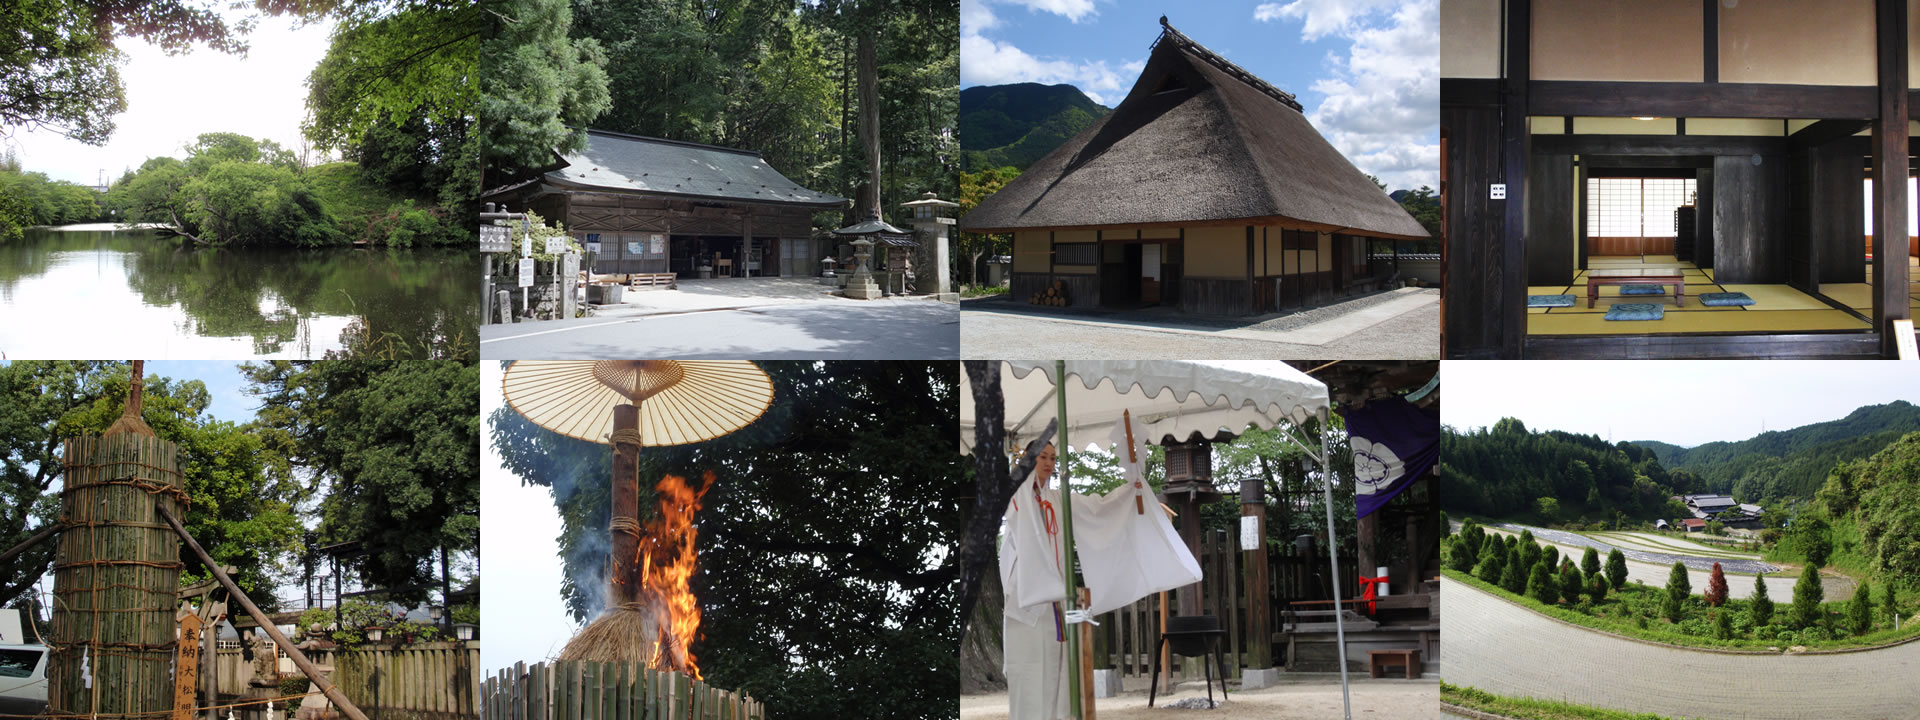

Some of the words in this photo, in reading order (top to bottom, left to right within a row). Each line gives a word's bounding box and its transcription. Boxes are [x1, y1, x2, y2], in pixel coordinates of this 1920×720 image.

[181, 628, 196, 715] 奉納大松明
